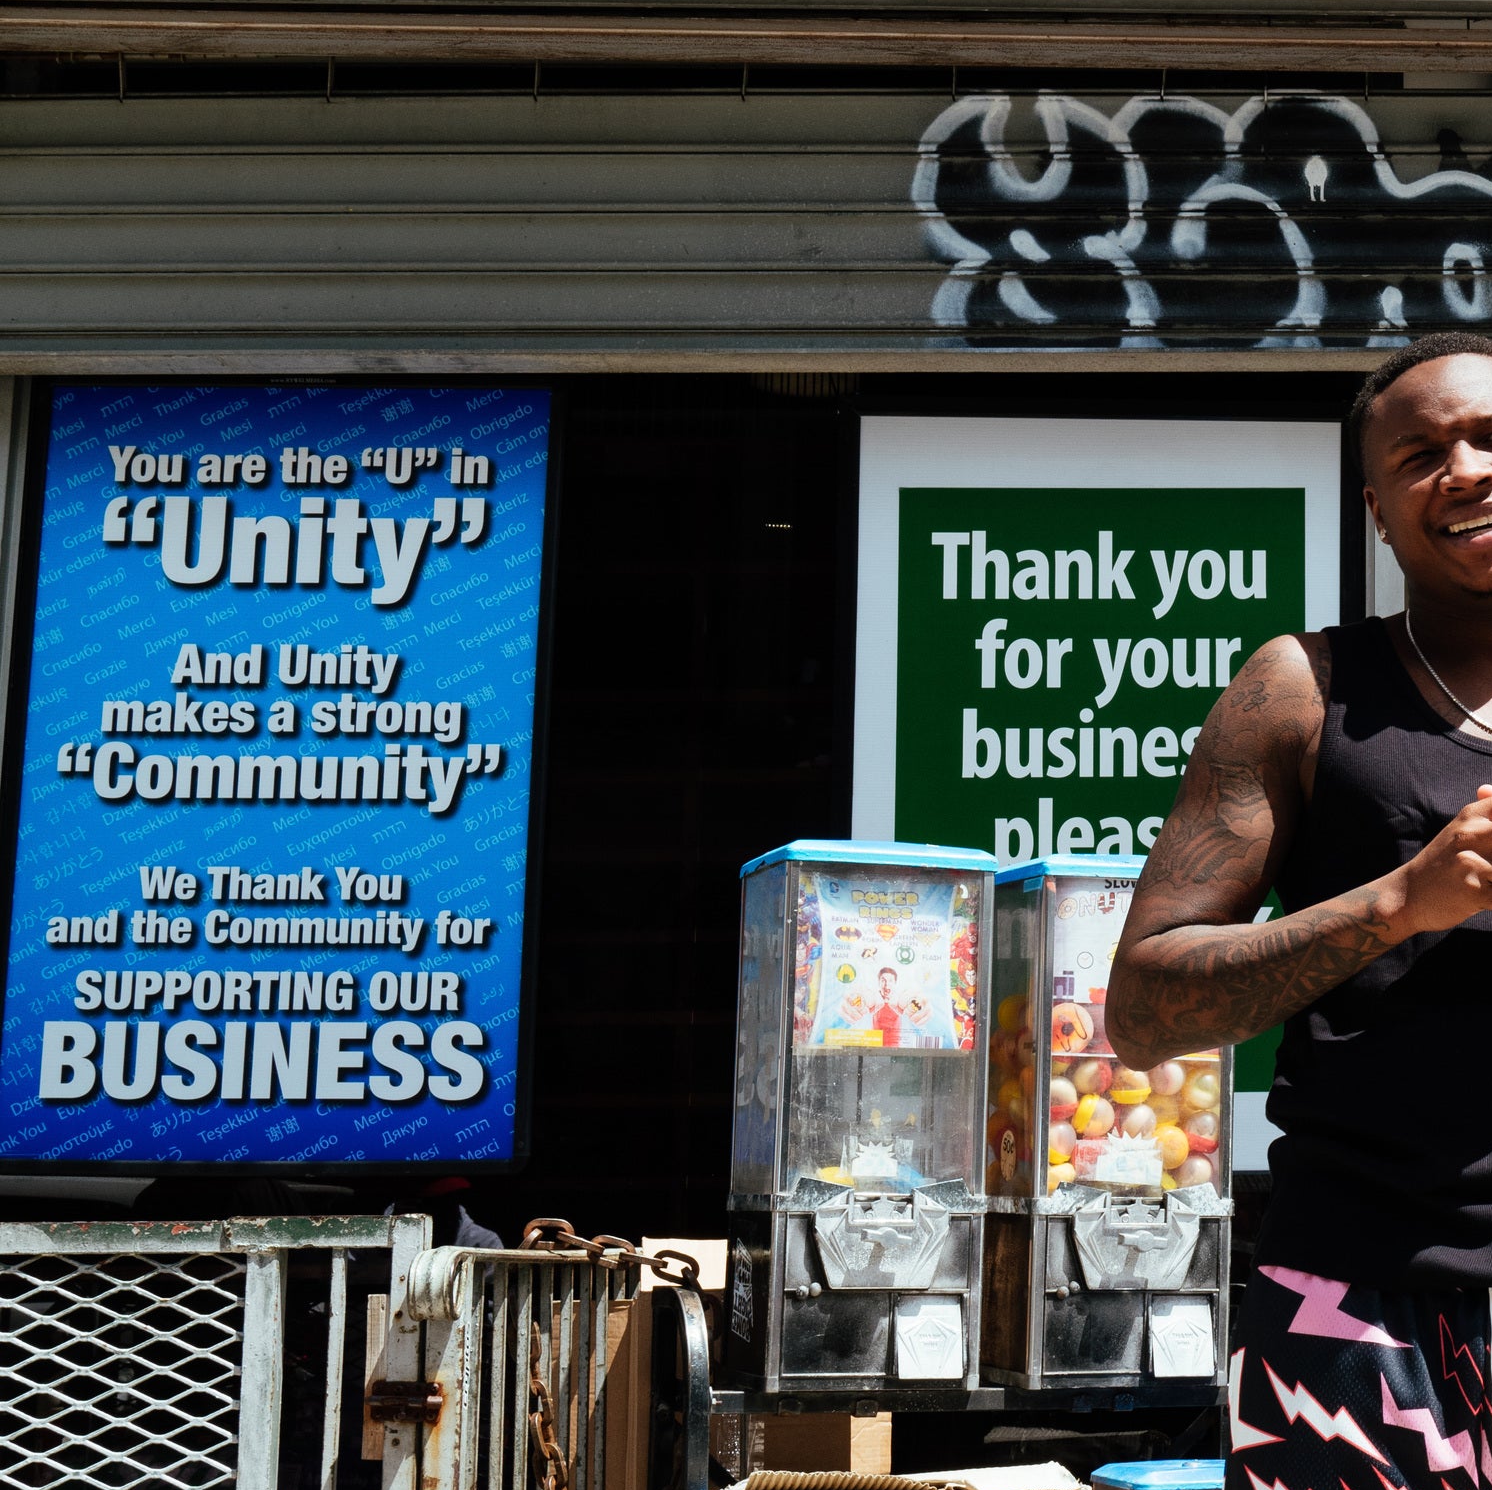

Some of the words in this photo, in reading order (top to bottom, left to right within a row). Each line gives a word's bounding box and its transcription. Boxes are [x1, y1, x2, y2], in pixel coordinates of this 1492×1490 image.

[104, 413, 144, 440] Merci
[200, 397, 249, 427] Gracias
[381, 397, 415, 423] 谢谢
[470, 403, 533, 441] Obrigado
[53, 417, 85, 442] Mesi
[392, 413, 451, 449] Спасибо
[108, 446, 183, 483] You
[197, 454, 266, 483] are
[280, 447, 348, 484] the
[450, 447, 489, 484] in
[62, 522, 104, 550] Grazie
[103, 496, 485, 605] “Unity”
[931, 530, 1136, 600] Thank
[1150, 550, 1267, 620] you
[143, 627, 189, 658] Дякую
[170, 644, 262, 684] And
[279, 644, 398, 694] Unity
[975, 618, 1073, 689] for
[1093, 637, 1242, 708] your
[101, 692, 255, 733] makes
[267, 701, 295, 733] a
[311, 693, 461, 742] strong
[962, 709, 1202, 779] busines
[57, 741, 500, 813] “Community”
[118, 811, 179, 846] Teşekkür
[463, 788, 531, 834] ありがとう
[994, 798, 1166, 865] pleas
[140, 866, 197, 900] We
[207, 866, 325, 901] Thank
[334, 866, 402, 901] You
[851, 890, 920, 906] POWER
[46, 909, 118, 944] and
[130, 909, 192, 944] the
[204, 910, 424, 952] Community
[436, 910, 491, 945] for
[858, 906, 913, 920] RINGS
[74, 970, 354, 1011] SUPPORTING
[369, 971, 459, 1011] OUR
[39, 1020, 485, 1101] BUSINESS
